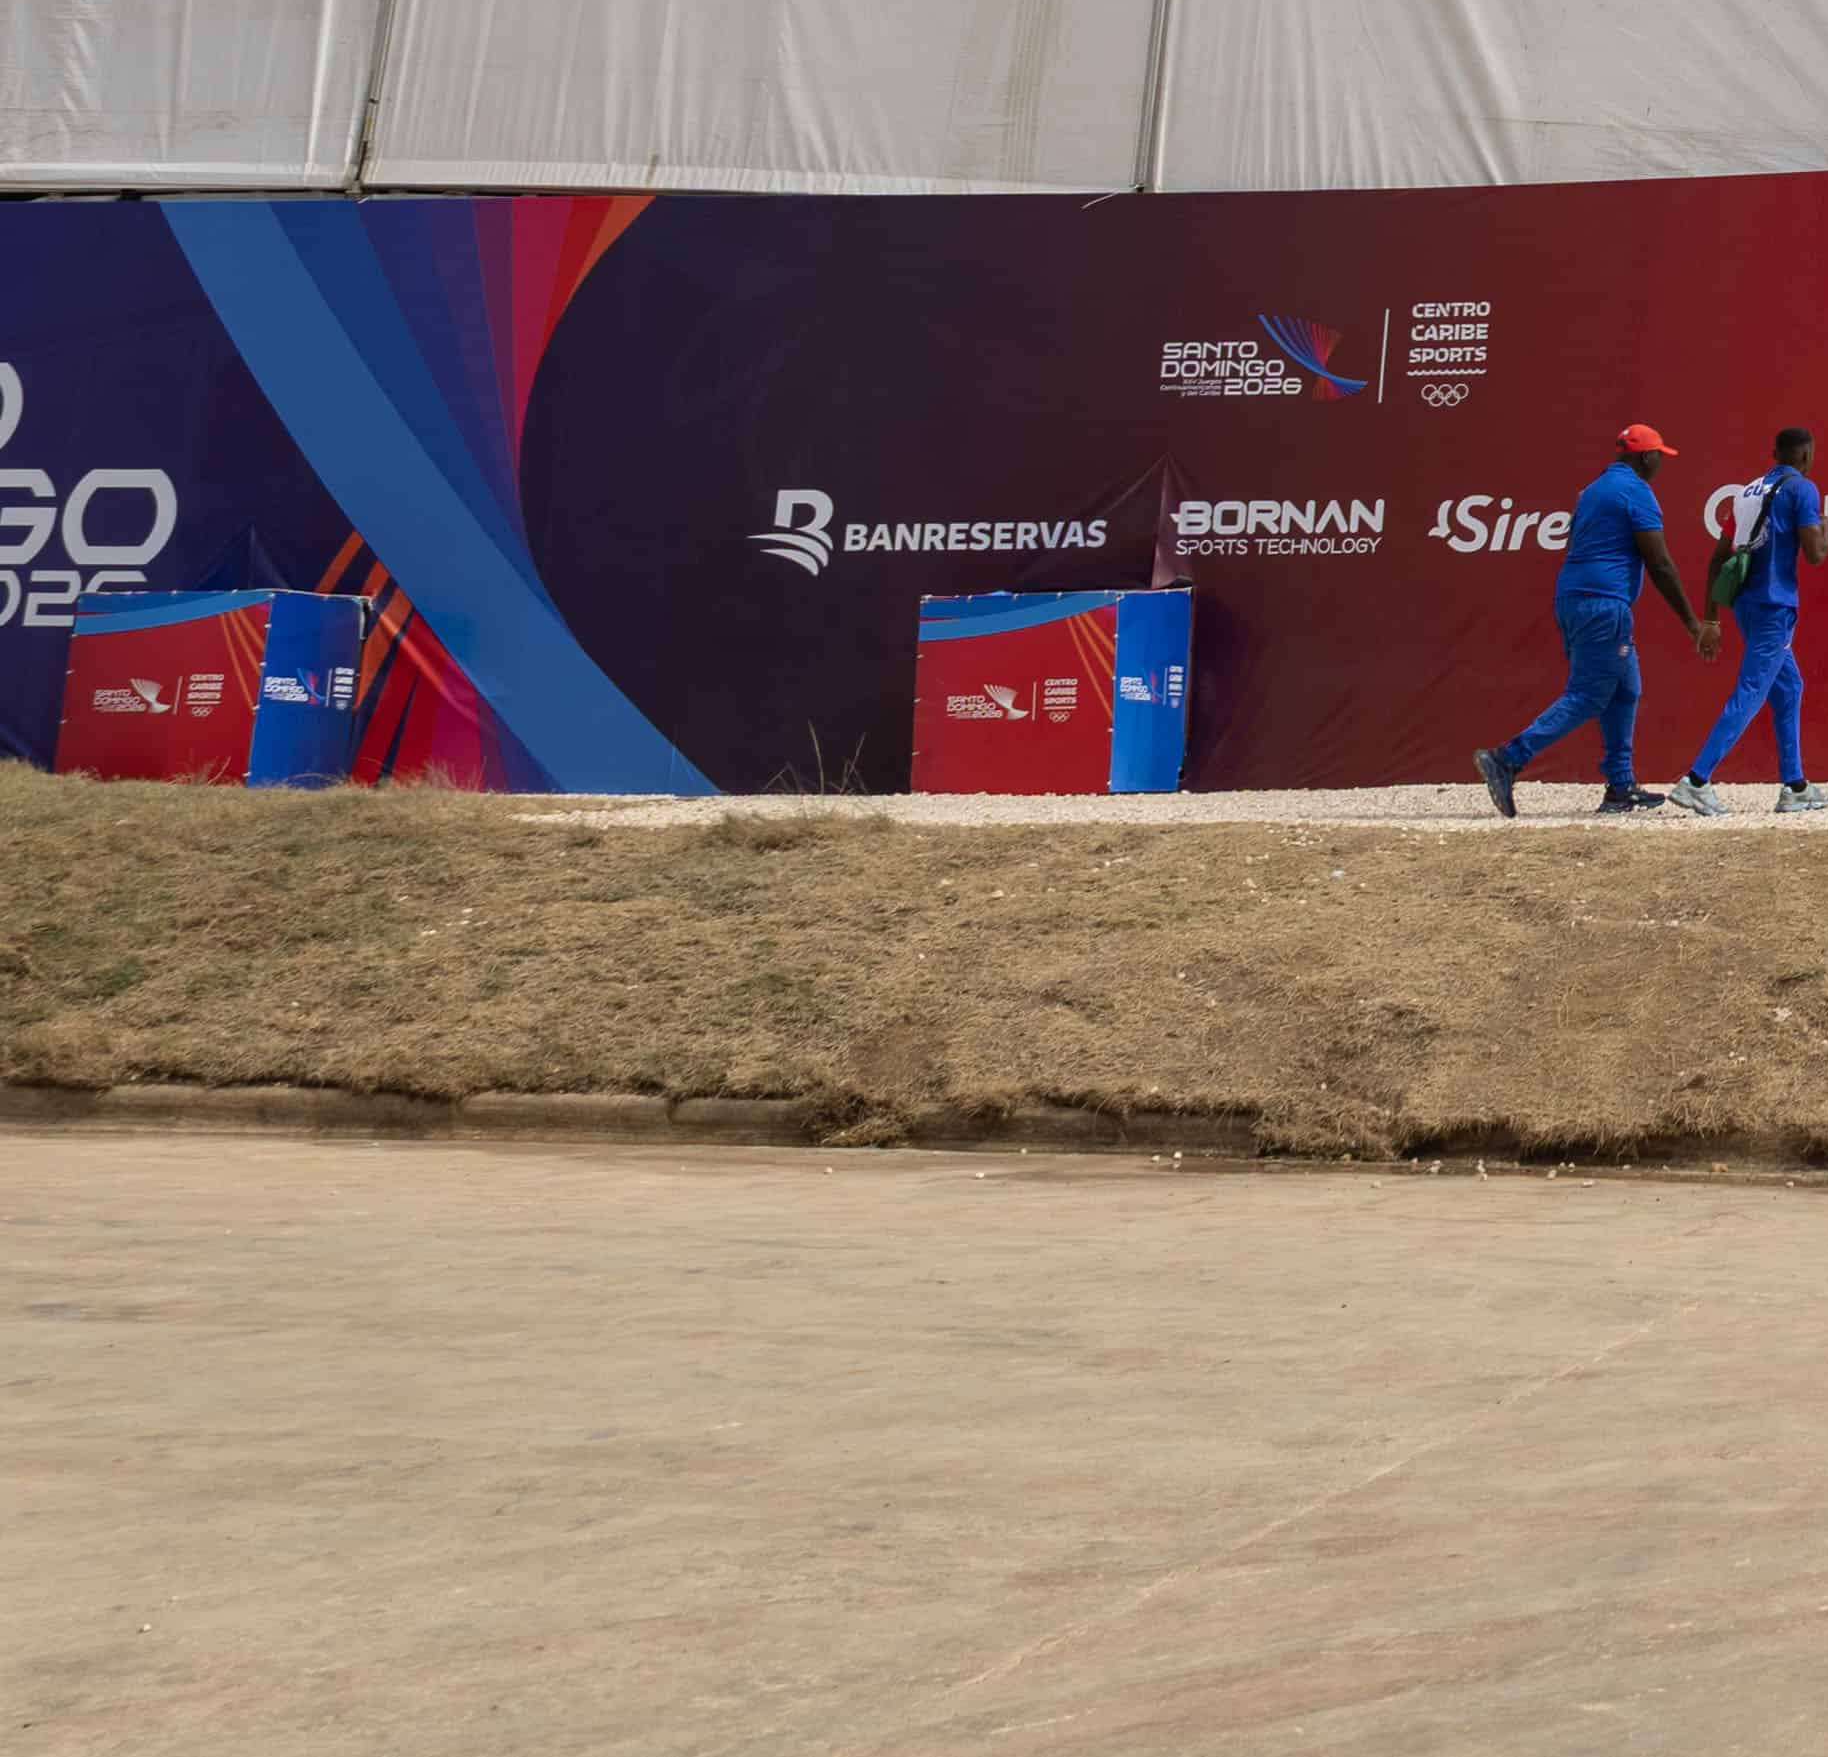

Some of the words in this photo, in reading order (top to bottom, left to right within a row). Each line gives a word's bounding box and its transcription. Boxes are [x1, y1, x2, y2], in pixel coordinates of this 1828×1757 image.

[1412, 301, 1491, 318] CENTRO
[1410, 323, 1489, 341] CARIBE
[1162, 341, 1258, 360] SANTO
[1408, 347, 1488, 364] SPORTS
[1160, 359, 1285, 379] DOMINGO
[1223, 377, 1303, 396] 2026
[1170, 499, 1385, 535] BORNAN
[1447, 494, 1572, 553] Sire
[844, 519, 1109, 552] BANRESERVAS
[1175, 539, 1249, 555] SPORTS
[1255, 537, 1383, 555] TECHNOLOGY
